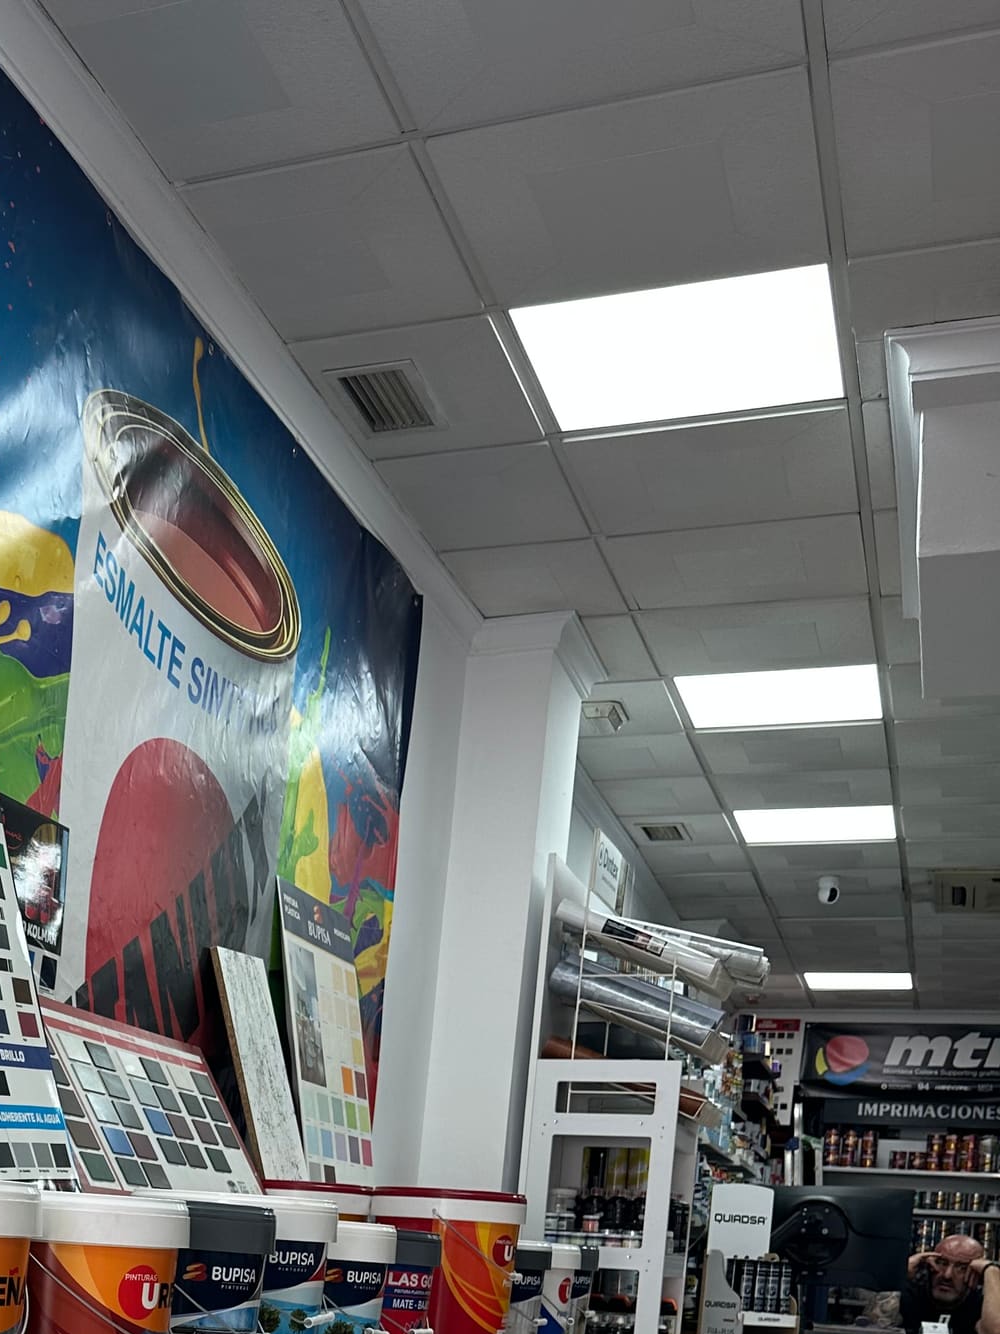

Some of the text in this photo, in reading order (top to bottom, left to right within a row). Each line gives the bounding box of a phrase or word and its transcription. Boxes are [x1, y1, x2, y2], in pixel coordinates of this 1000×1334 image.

[93, 530, 186, 690] ESMALTE
[27, 922, 57, 947] KOLMAN
[0, 1048, 26, 1063] BRILLO
[43, 1111, 62, 1124] AGUA
[714, 1213, 766, 1225] QUIADSA
[269, 1251, 315, 1266] BUPISA
[125, 1273, 158, 1282] PINTURAS
[212, 1266, 256, 1283] BUPISA
[346, 1270, 382, 1285] BUPISA
[388, 1271, 419, 1287] LAS
[392, 1298, 414, 1309] MATE
